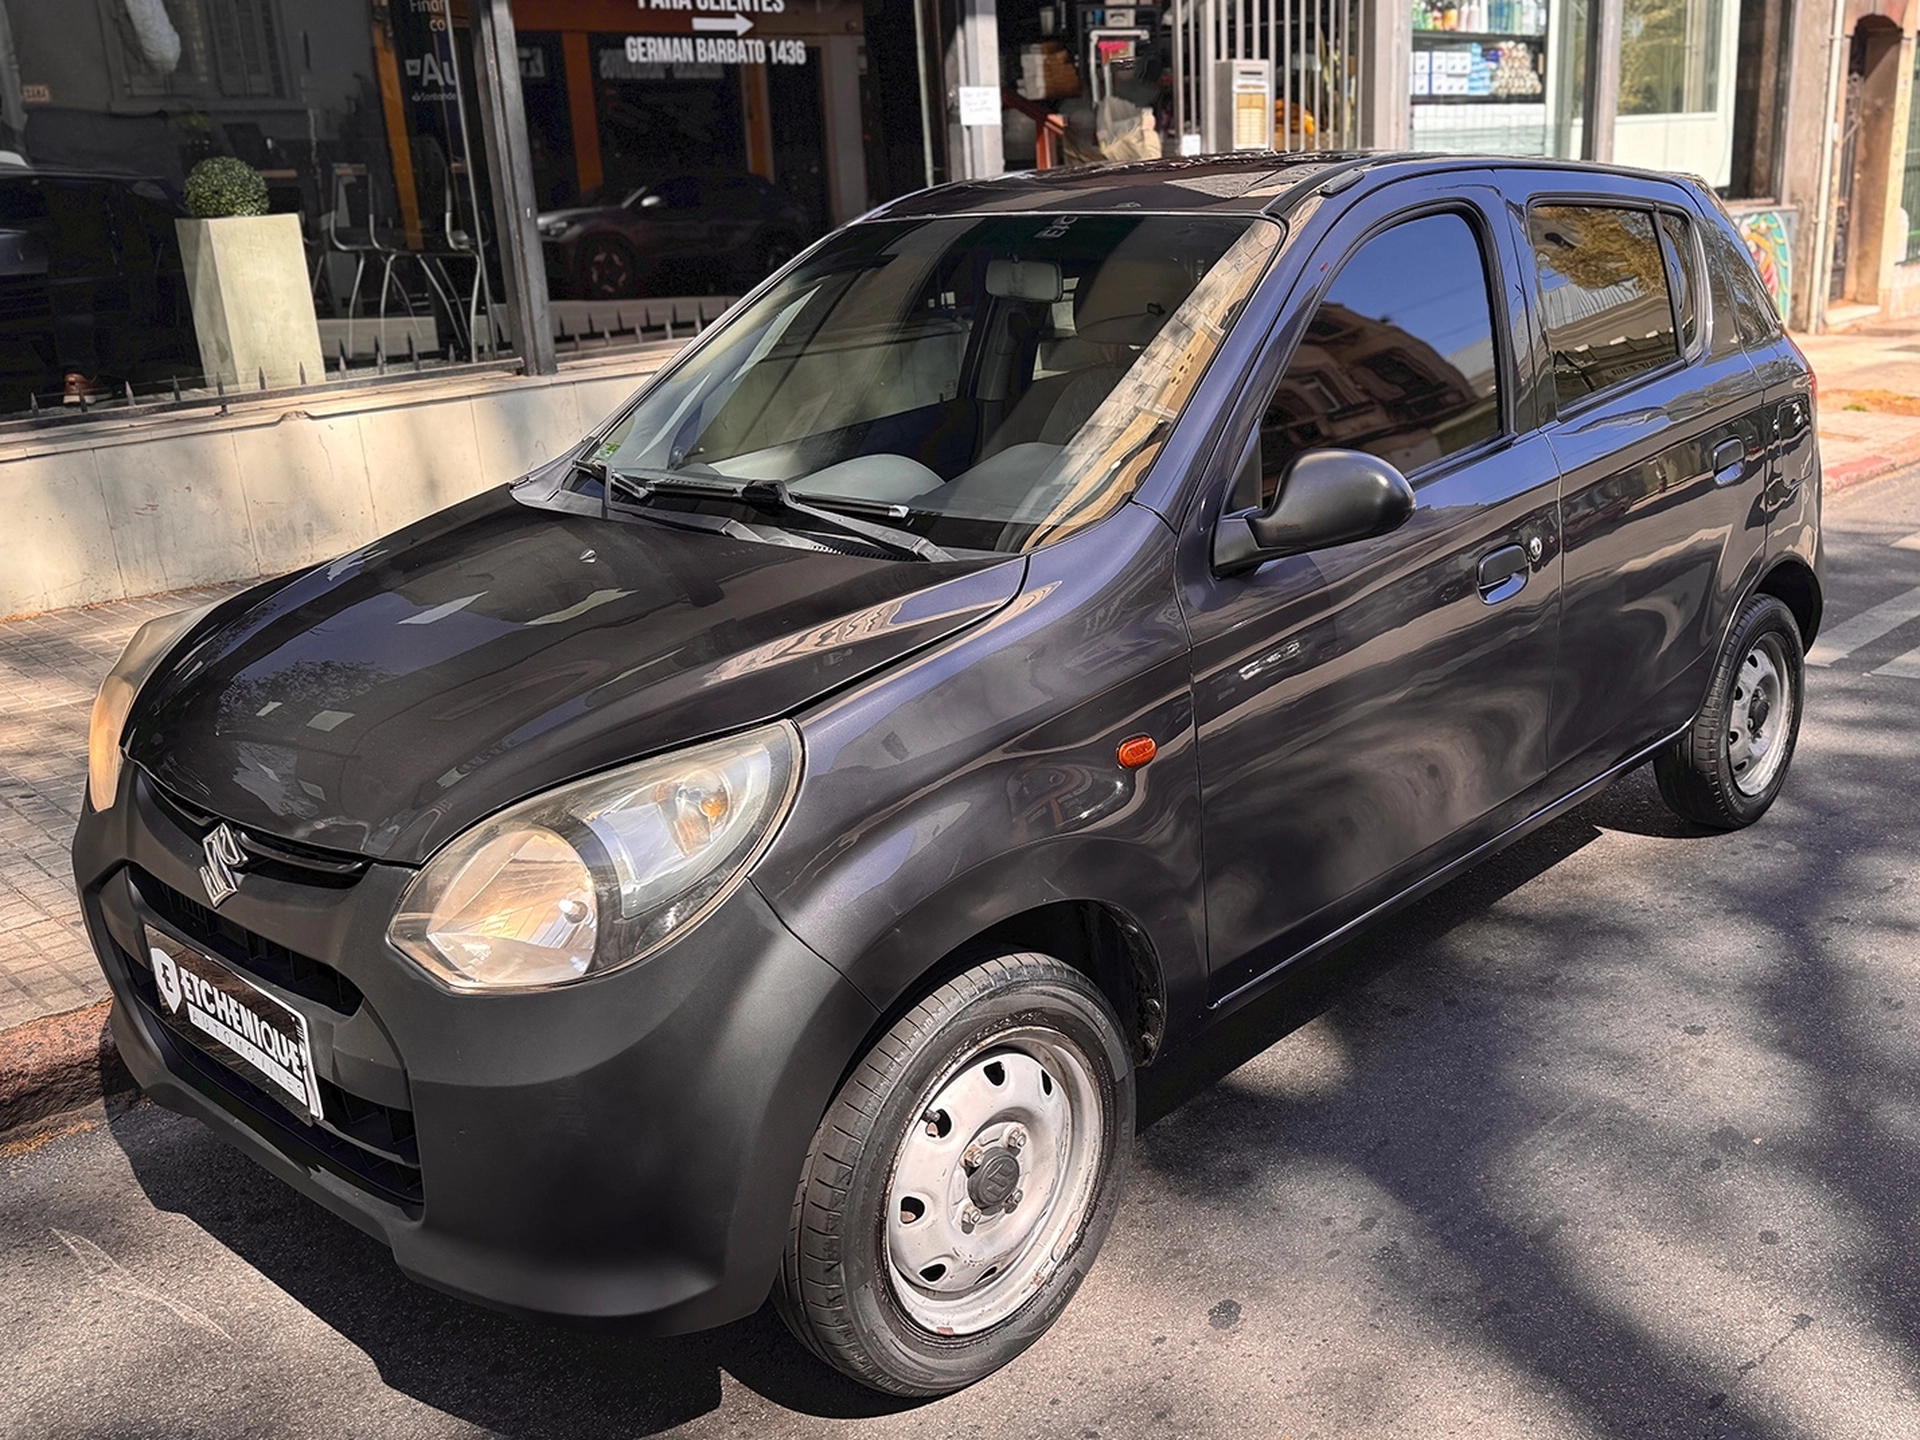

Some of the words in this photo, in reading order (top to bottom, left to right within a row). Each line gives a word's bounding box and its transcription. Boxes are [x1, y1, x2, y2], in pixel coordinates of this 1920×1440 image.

[625, 36, 694, 63] GERMAN
[695, 38, 766, 64] BARBATO
[770, 39, 806, 64] 1436
[180, 966, 304, 1080] ETCHENIQUE
[191, 1011, 306, 1100] AUTOMOVILES
